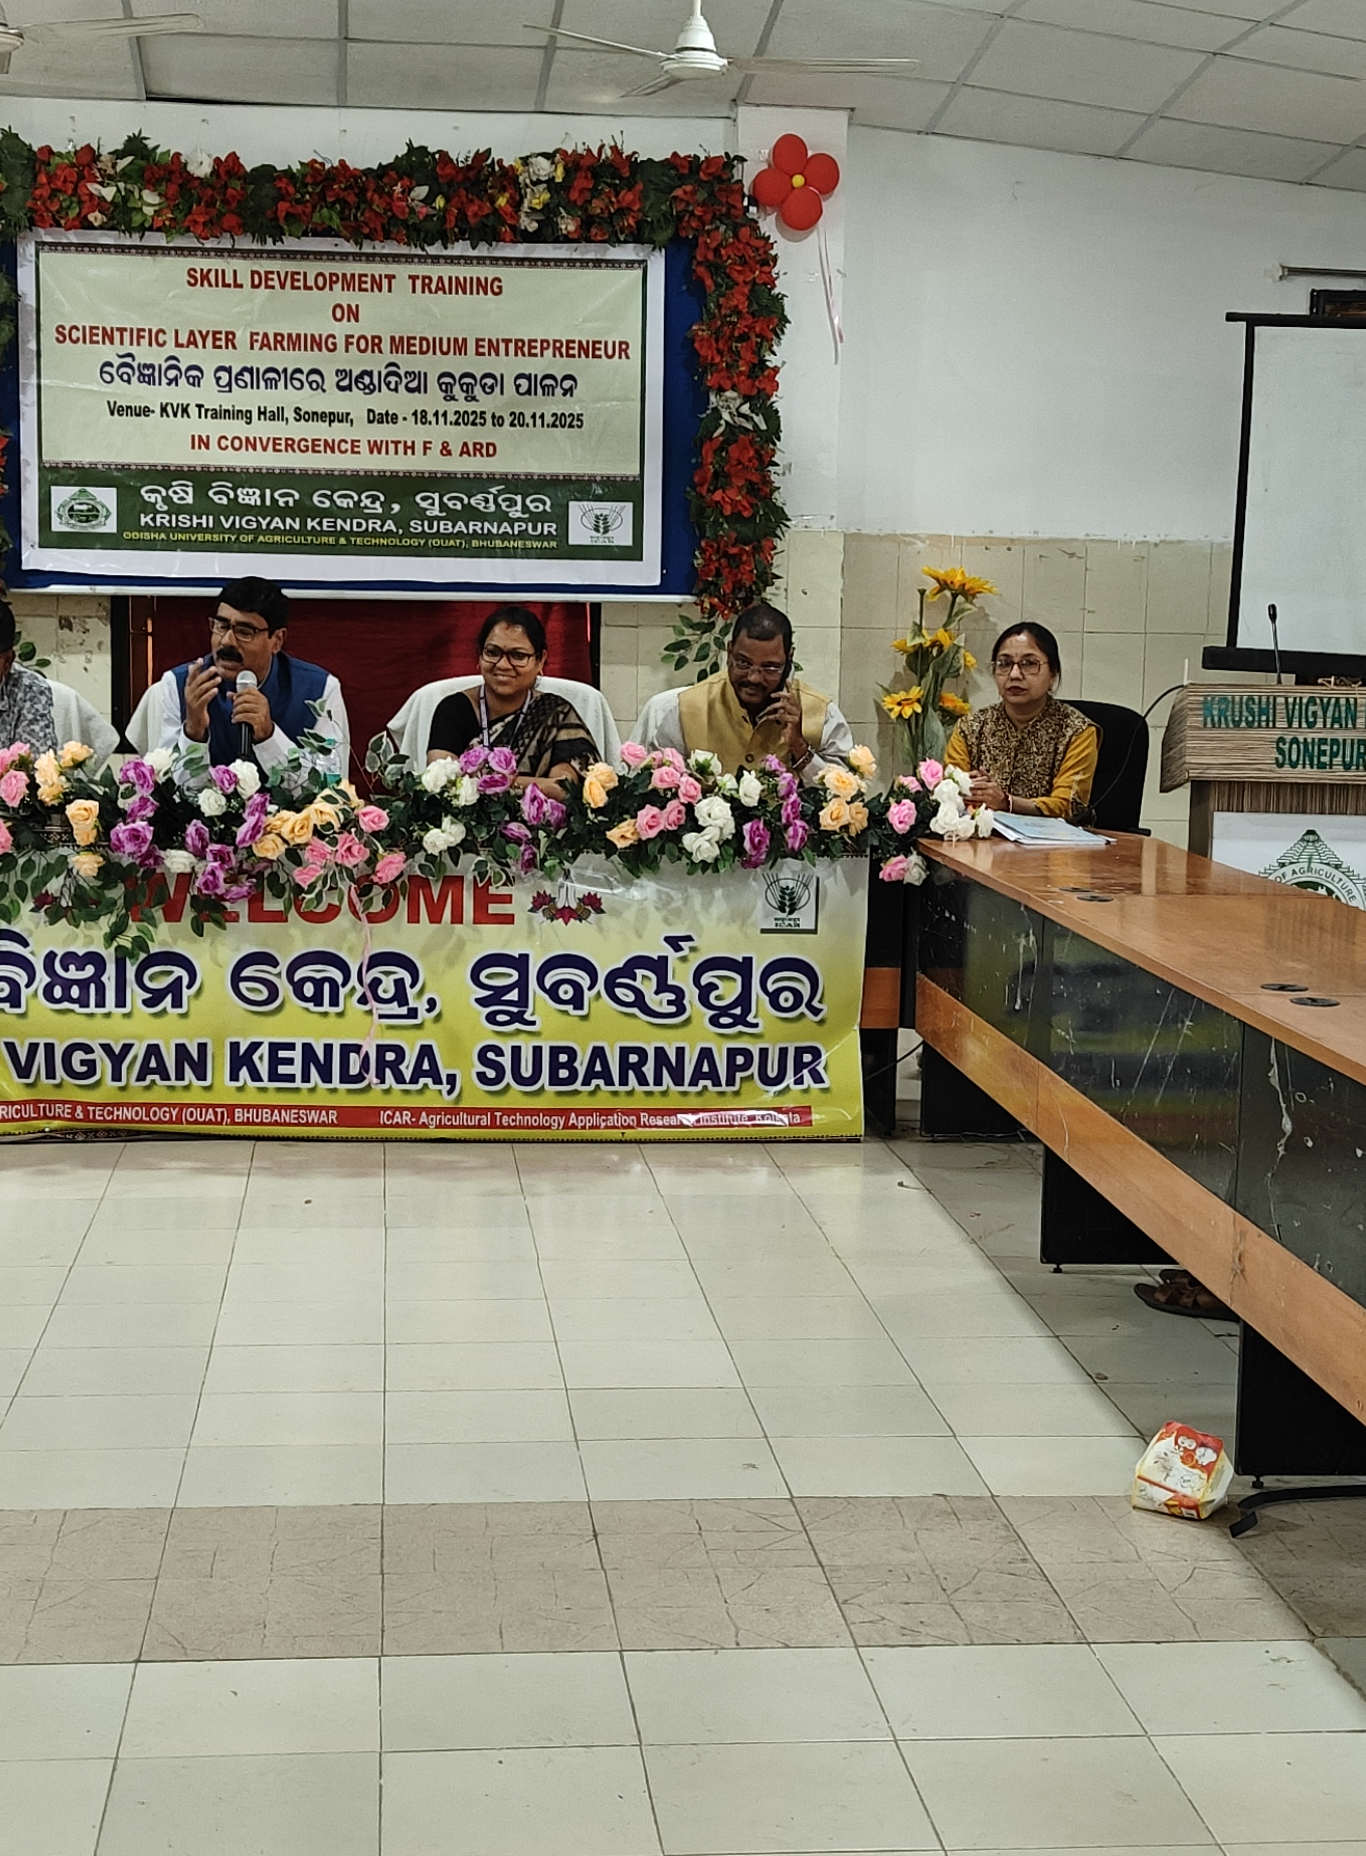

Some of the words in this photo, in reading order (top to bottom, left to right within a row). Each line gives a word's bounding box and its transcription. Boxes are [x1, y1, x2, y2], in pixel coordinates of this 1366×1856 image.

[186, 267, 244, 289] SKILL
[250, 269, 396, 293] DEVELOPMENT
[408, 274, 503, 296] TRAINING
[331, 303, 360, 323] ON
[54, 324, 167, 347] SCIENTIFIC
[173, 328, 237, 350] LAYER
[249, 331, 338, 352] FARMING
[344, 333, 384, 354] FOR
[389, 335, 468, 357] MEDIUM
[475, 337, 631, 360] ENTREPRENEUR
[99, 352, 205, 387] ବୈଜ୍ଞାନିକ
[213, 364, 327, 393] ପ୍ରଣାଳୀରେ
[513, 372, 578, 398] ପାଳନ
[106, 400, 156, 418] Venue-
[160, 402, 191, 419] KVK
[195, 404, 253, 425] Training
[257, 406, 289, 425] Hall,
[293, 406, 354, 428] Sonepur,
[367, 408, 399, 425] Date
[411, 409, 487, 427] 18.11.2025
[491, 412, 505, 427] to
[509, 411, 584, 429] 20.11.2025
[190, 434, 210, 451] IN
[217, 436, 362, 455] CONVERGENCE
[367, 439, 416, 456] WITH
[422, 440, 433, 456] F
[439, 440, 453, 457] &
[458, 442, 498, 458] ARD
[139, 480, 194, 510] କୃଷି
[207, 481, 300, 507] ବିଜ୍ଞାନ
[139, 513, 214, 528] KRISHI
[220, 515, 300, 531] VIGYAN
[306, 517, 404, 535] KENDRA,
[409, 519, 558, 536] SUBARNAPUR
[123, 531, 167, 541] ODISHA
[169, 532, 237, 542] UNIVERSITY
[240, 534, 255, 543] OF
[257, 534, 336, 545] AGRICULTURE
[338, 537, 347, 545] &
[350, 537, 426, 547] TECHNOLOGY
[471, 539, 558, 549] BHUBANESWAR
[1202, 695, 1277, 729] KRUSHI
[1284, 696, 1358, 730] VIGYAN
[123, 873, 516, 925] WLCOME
[1274, 872, 1288, 884] OF
[1291, 866, 1357, 903] AGRICULTURE
[4, 1041, 208, 1084] VIGYAN
[229, 1041, 457, 1097] KENDRA,
[476, 1044, 826, 1087] SUBARNAPUR
[75, 1104, 84, 1119] &
[87, 1106, 180, 1122] TECHNOLOGY
[182, 1107, 231, 1125] (OUAT),
[234, 1108, 338, 1124] BHUBANESWAR
[380, 1111, 416, 1125] ICAR-
[419, 1111, 491, 1128] Agricultural
[494, 1112, 565, 1129] Technology
[568, 1112, 636, 1129] Application
[640, 1112, 699, 1126] Resear
